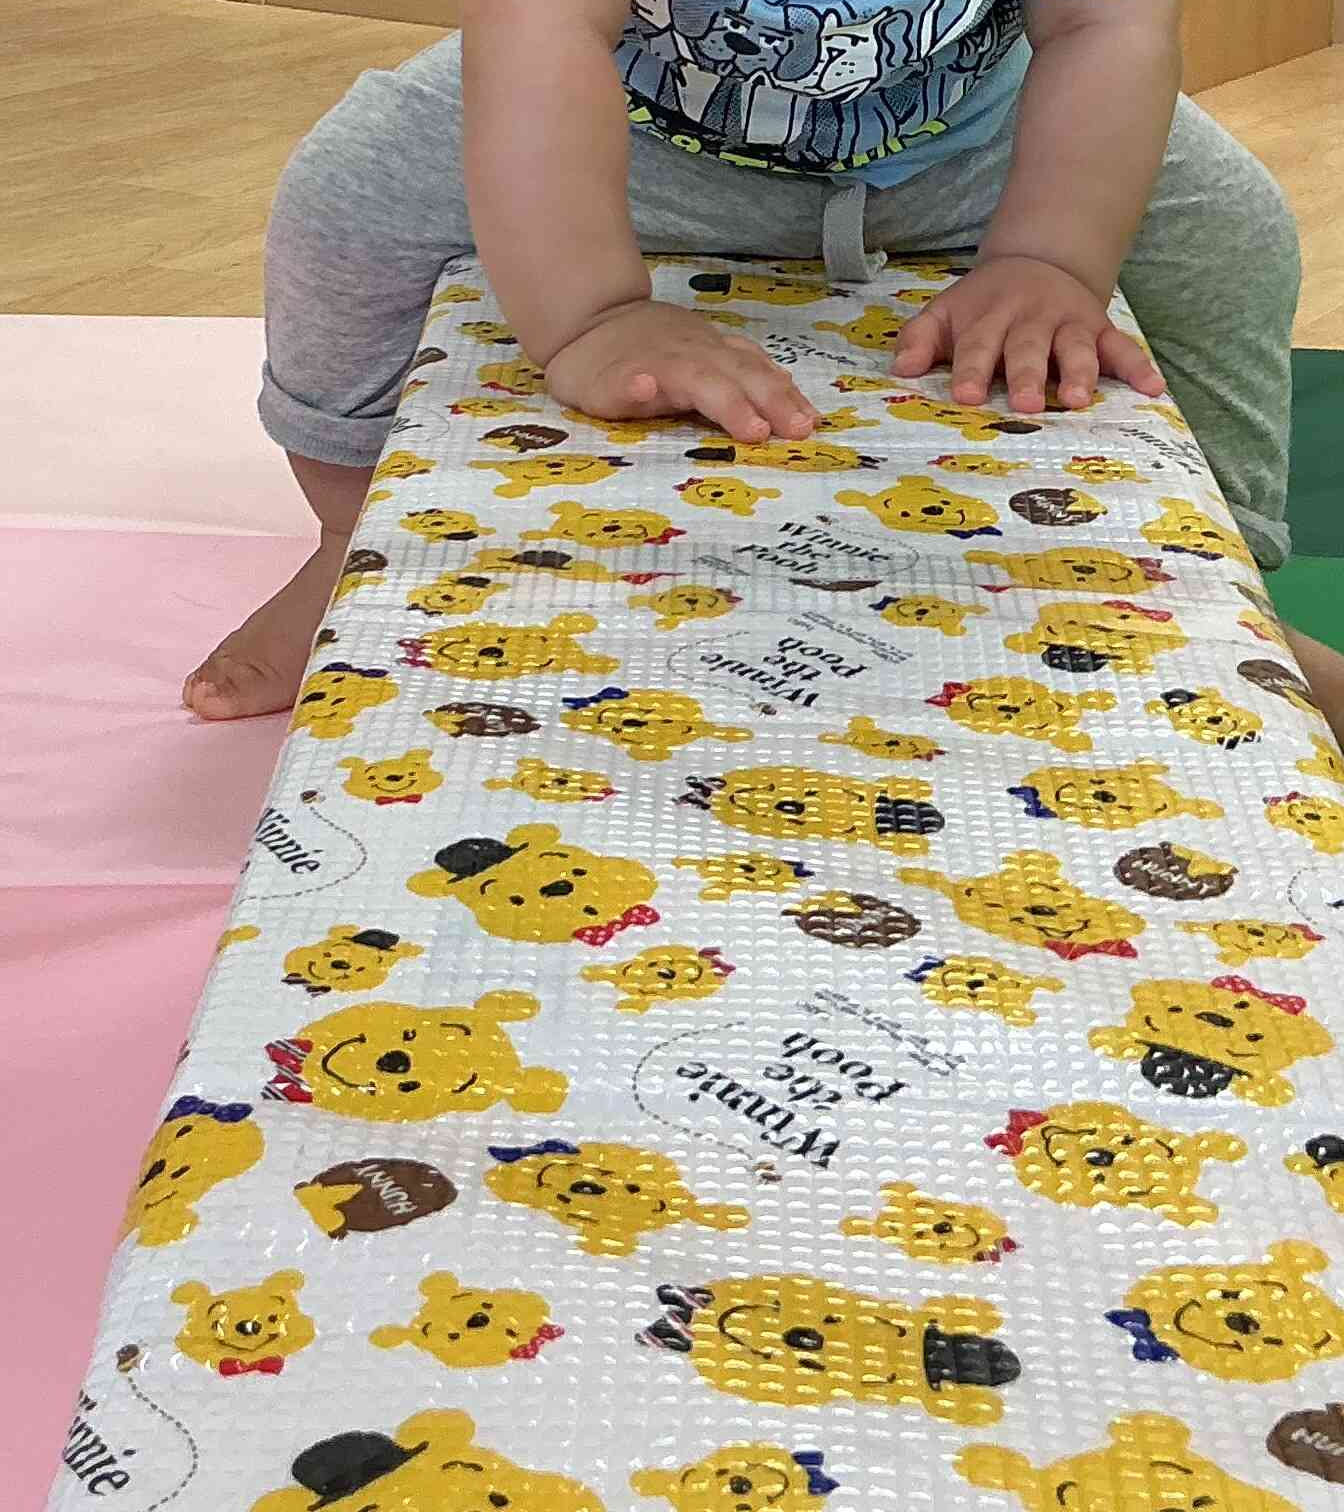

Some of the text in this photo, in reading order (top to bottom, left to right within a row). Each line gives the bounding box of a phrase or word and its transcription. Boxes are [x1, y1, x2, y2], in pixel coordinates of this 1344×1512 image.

[733, 543, 819, 575] Pooh
[775, 541, 832, 560] the
[778, 521, 891, 563] Winnie
[699, 652, 820, 707] Winnie
[762, 654, 822, 681] the
[777, 637, 868, 678] Pooh
[762, 1063, 843, 1111] the
[781, 1031, 910, 1103] Pooh
[676, 1061, 841, 1169] Winnie
[355, 1163, 419, 1217] HUNNY
